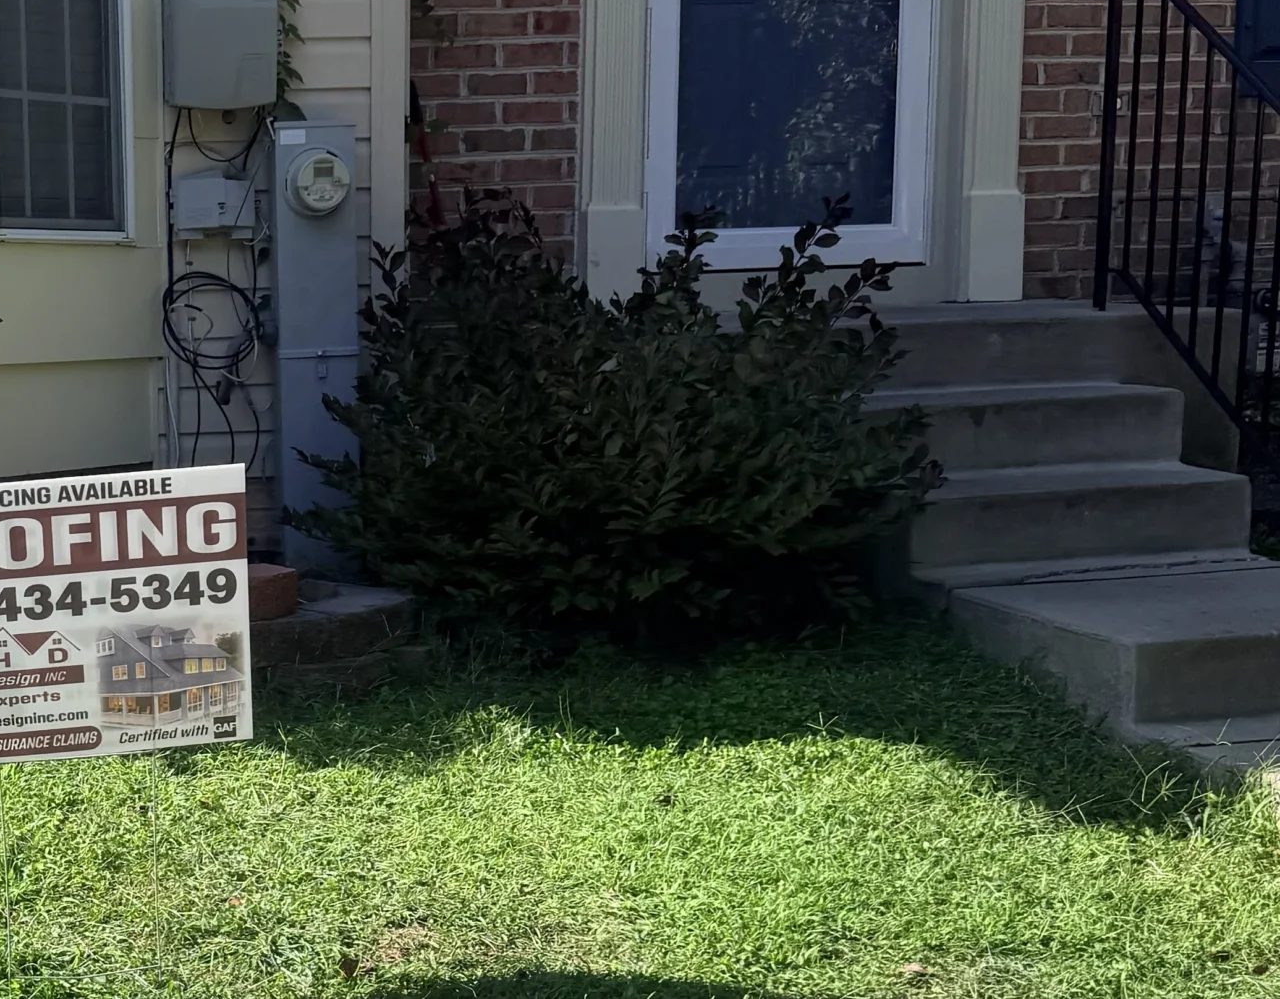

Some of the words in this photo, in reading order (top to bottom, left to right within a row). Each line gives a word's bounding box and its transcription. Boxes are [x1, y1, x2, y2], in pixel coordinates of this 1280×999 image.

[58, 477, 172, 503] AVAILABLE
[48, 647, 69, 664] D
[45, 671, 67, 683] INC
[53, 731, 98, 746] CLAIMS
[119, 727, 178, 744] Certified
[181, 724, 209, 737] with
[214, 722, 237, 733] GAF
